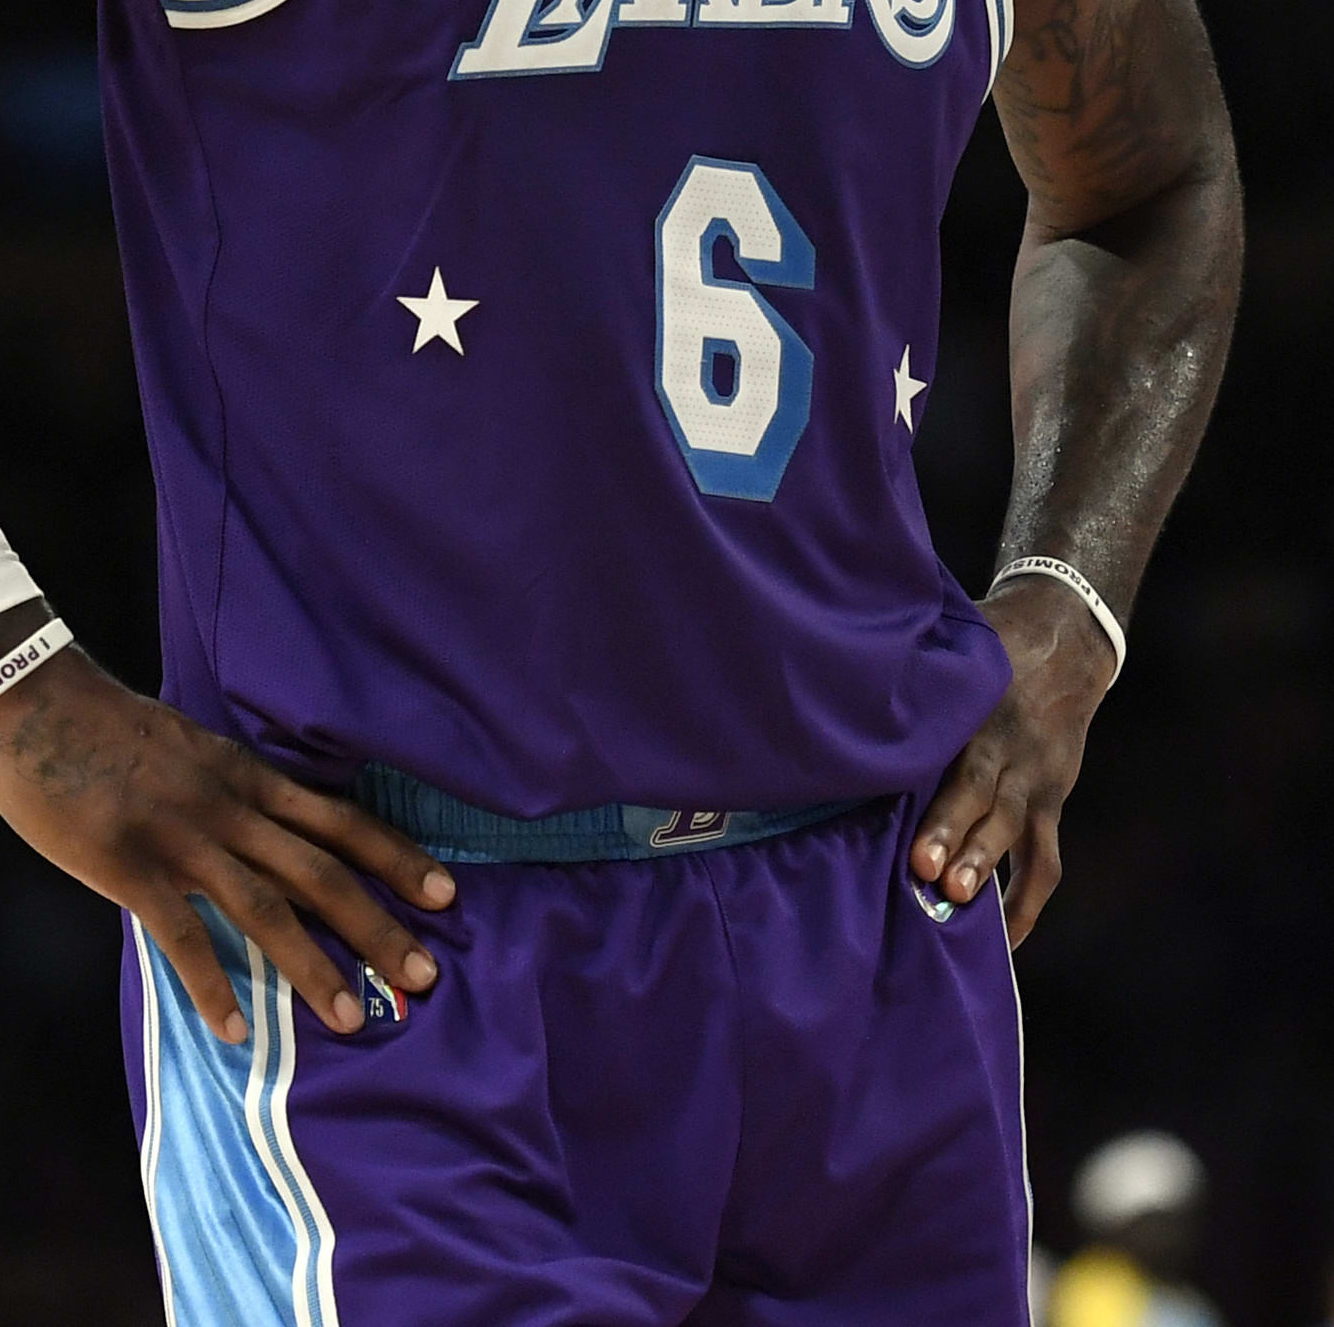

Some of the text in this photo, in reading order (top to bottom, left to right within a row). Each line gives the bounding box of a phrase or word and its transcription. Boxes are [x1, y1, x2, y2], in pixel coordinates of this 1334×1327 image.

[654, 154, 817, 503] 6
[39, 637, 51, 651] I
[368, 997, 384, 1017] 75
